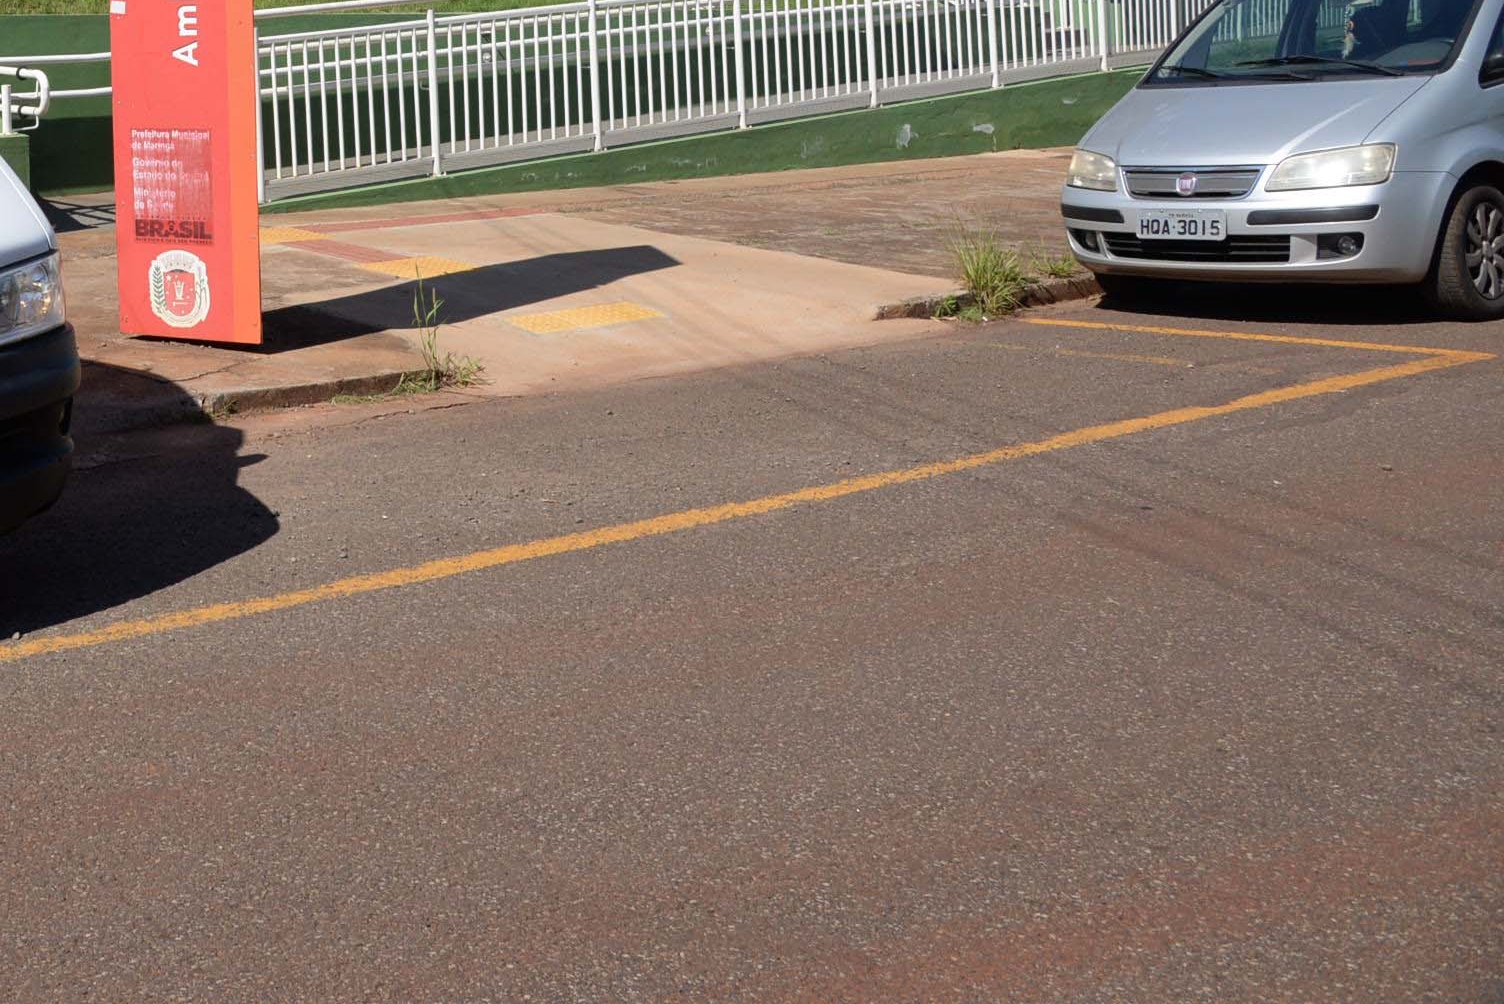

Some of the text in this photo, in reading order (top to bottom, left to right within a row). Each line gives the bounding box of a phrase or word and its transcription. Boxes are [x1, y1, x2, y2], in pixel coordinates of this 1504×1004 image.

[131, 129, 170, 140] Prefeitura
[133, 157, 169, 167] Governo
[133, 171, 163, 180] Estado
[135, 219, 212, 239] BRASIL
